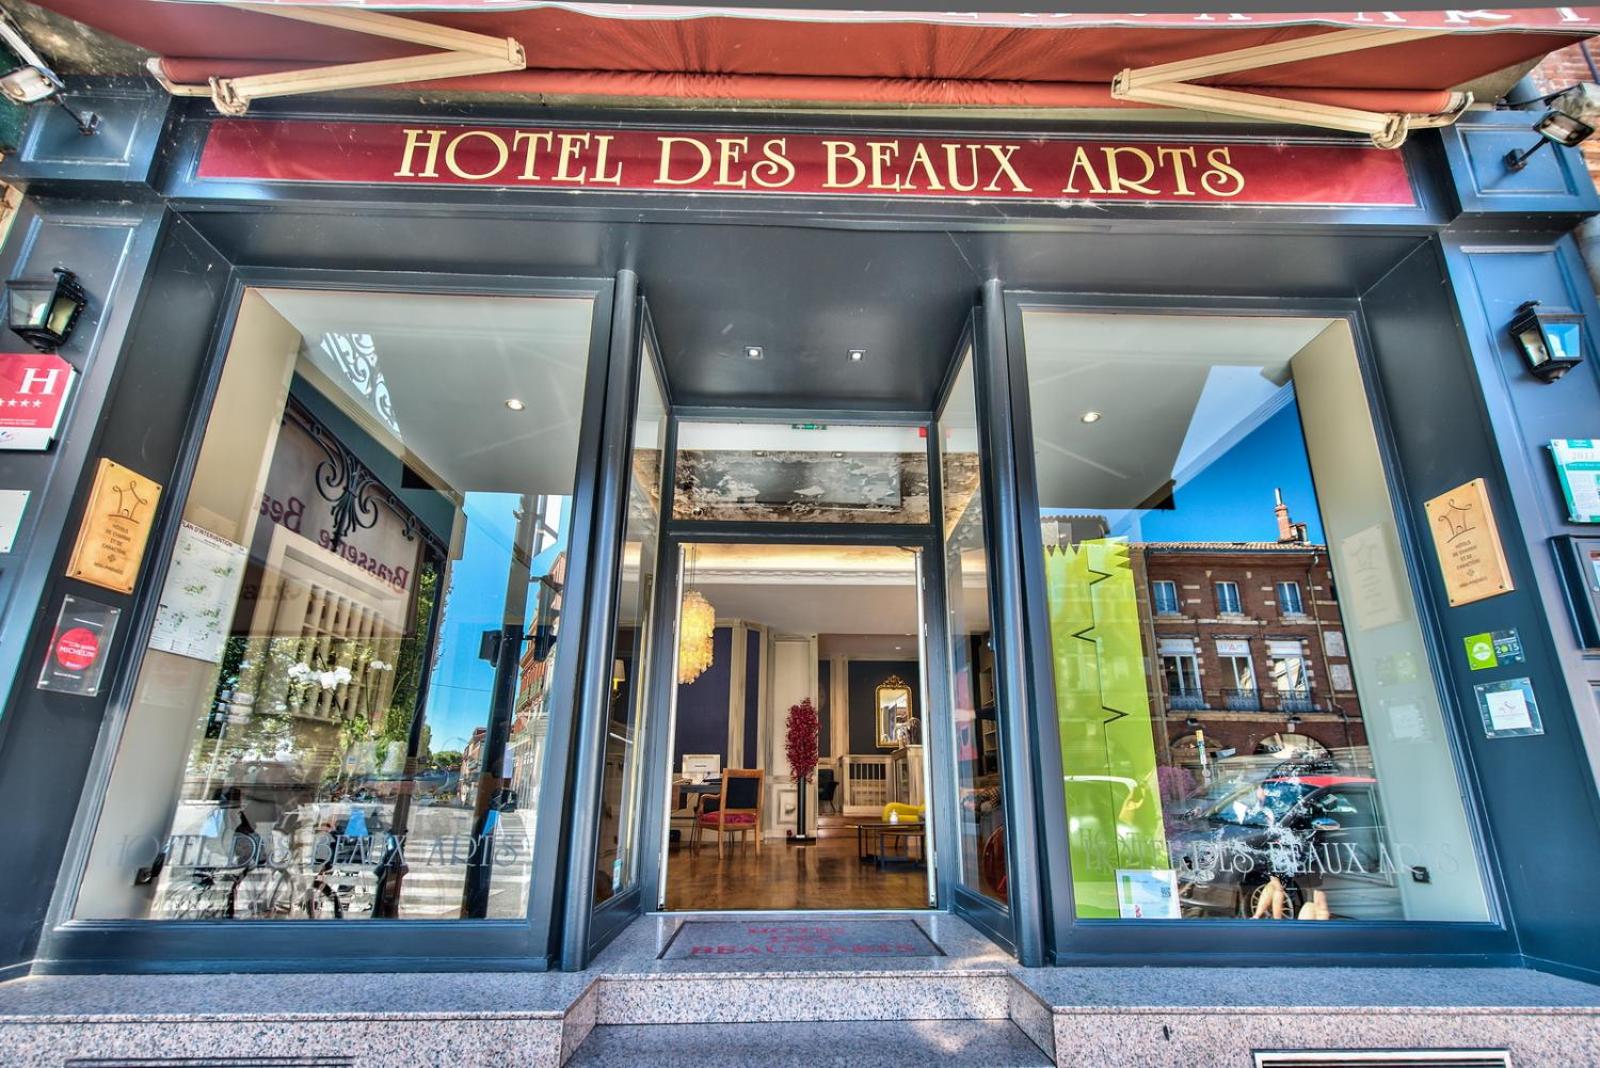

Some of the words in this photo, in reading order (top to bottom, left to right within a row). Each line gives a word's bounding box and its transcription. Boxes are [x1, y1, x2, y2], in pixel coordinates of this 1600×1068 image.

[393, 127, 624, 187] HOTEL
[655, 135, 797, 190] DES
[822, 139, 1033, 194] BEAUX
[1062, 145, 1246, 198] ARTS
[16, 367, 63, 395] H
[59, 646, 96, 658] MICHELIN
